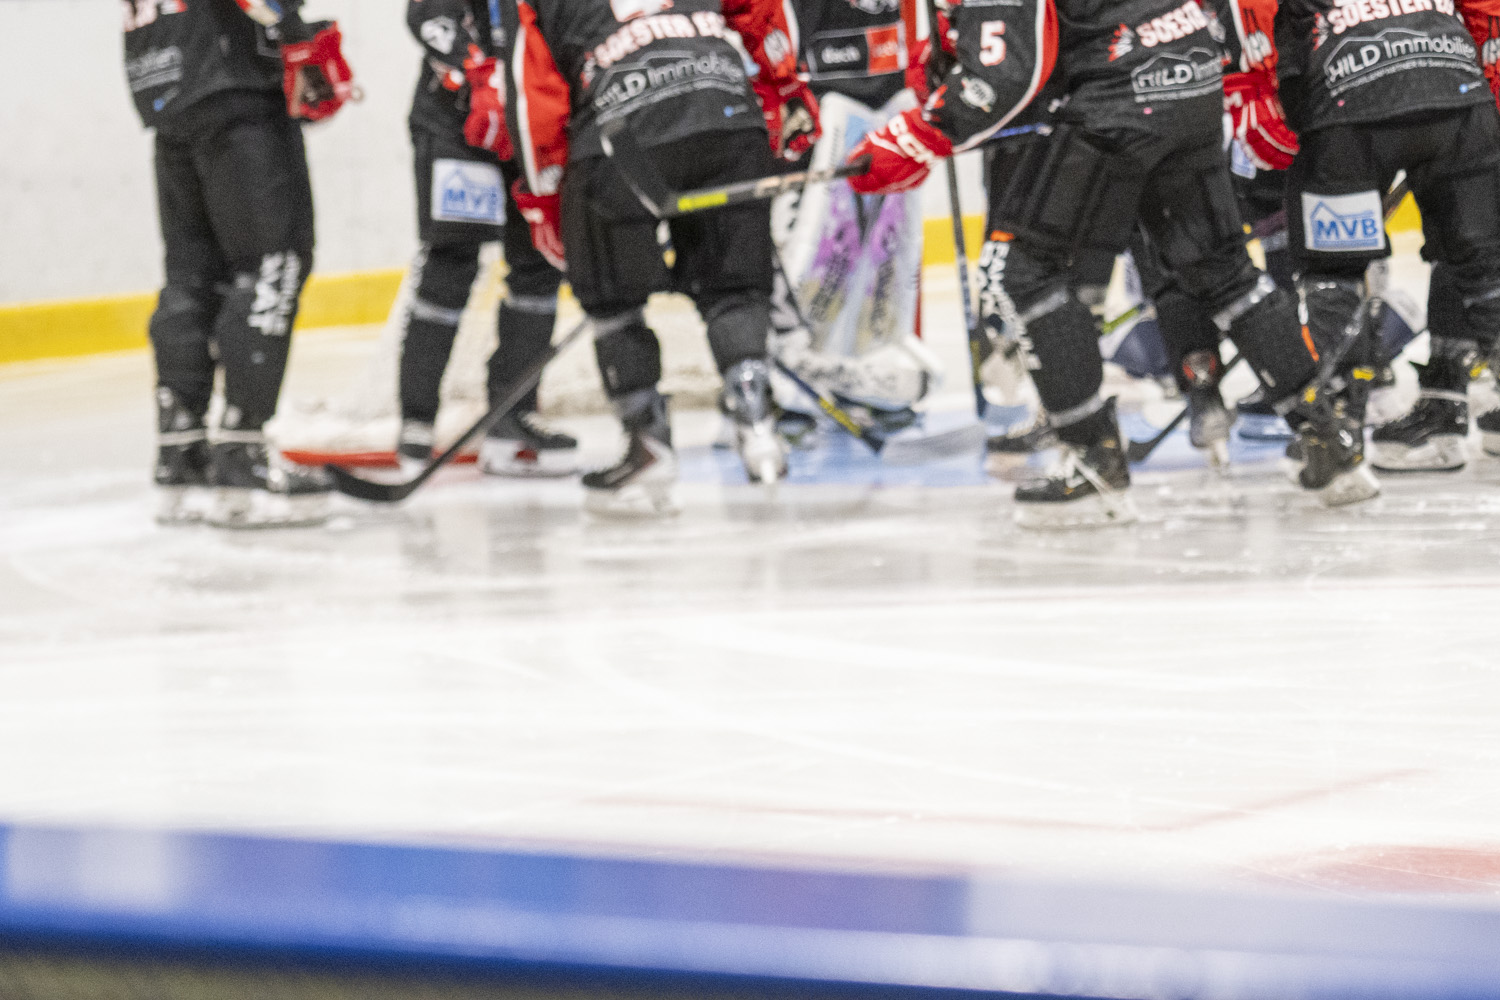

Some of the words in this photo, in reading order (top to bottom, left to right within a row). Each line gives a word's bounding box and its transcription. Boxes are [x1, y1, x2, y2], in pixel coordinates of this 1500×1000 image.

[979, 20, 1007, 67] 5
[1330, 43, 1381, 84] HILD
[1316, 218, 1378, 240] MVB
